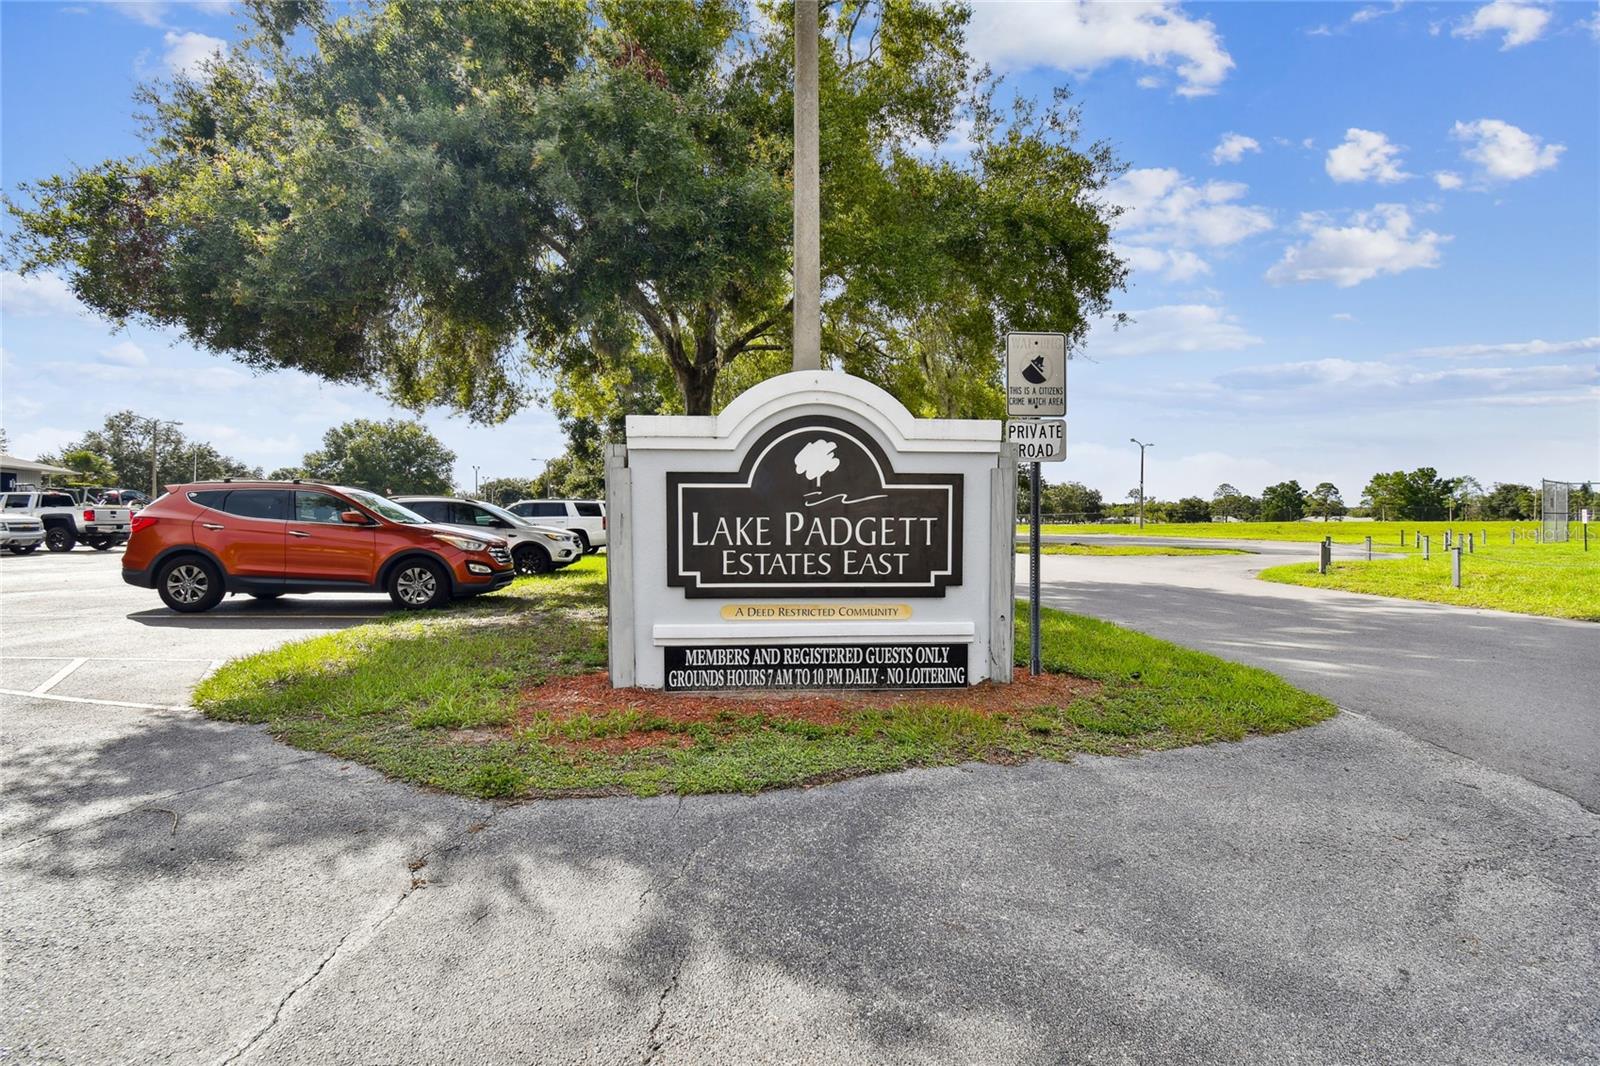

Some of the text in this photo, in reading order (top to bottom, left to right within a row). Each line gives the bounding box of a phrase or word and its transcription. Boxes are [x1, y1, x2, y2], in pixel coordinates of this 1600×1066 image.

[1009, 387, 1064, 395] THIS IS A CITIZENS
[1009, 397, 1064, 406] CRIME WATCH AREA
[1008, 424, 1063, 439] PRIVATE
[1018, 443, 1054, 458] ROAD
[692, 511, 938, 546] LAKE PADGETT
[722, 550, 910, 576] ESTATES EAST
[735, 607, 899, 617] A DEED RESTRICTED COMMUNITY
[685, 646, 950, 666] MEMBERS AND REGISTERED GUESTS ONLY
[668, 669, 725, 687] GROUNDS
[726, 669, 766, 687] HOURS
[767, 669, 774, 686] 7
[775, 669, 793, 685] AM
[795, 668, 811, 686] TO
[812, 668, 824, 685] 10
[826, 668, 843, 685] PM
[845, 668, 879, 685] DAILY
[887, 668, 904, 685] NO
[906, 667, 965, 685] LOITERING
